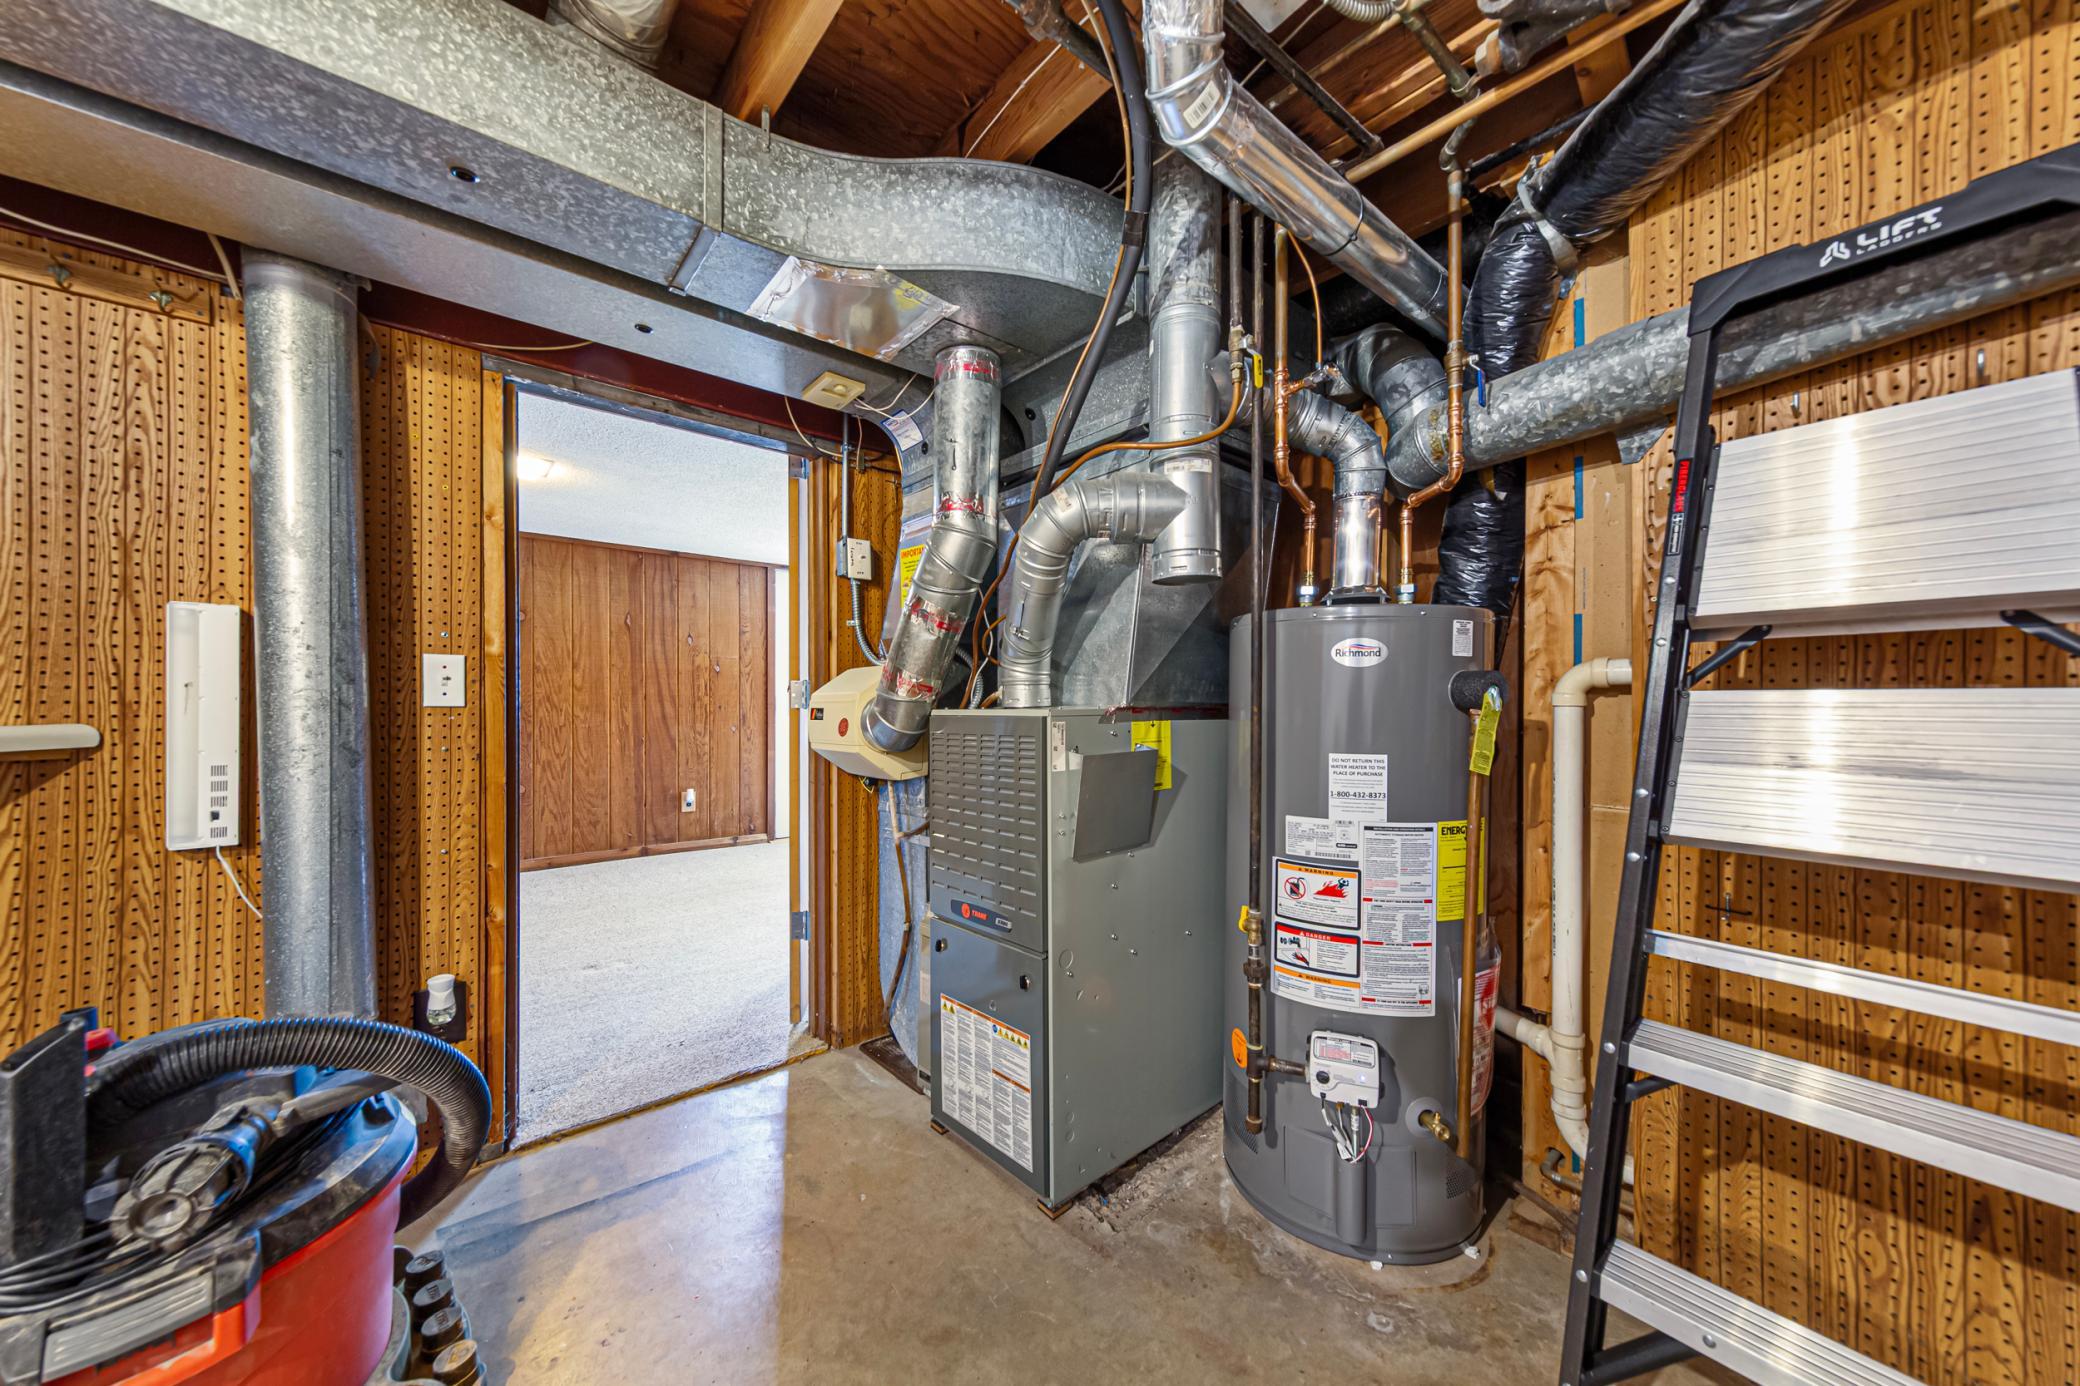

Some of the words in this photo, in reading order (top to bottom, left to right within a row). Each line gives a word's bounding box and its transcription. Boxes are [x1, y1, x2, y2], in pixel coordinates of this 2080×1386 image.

[1856, 206, 1943, 247] LIFT
[1335, 647, 1381, 657] Richmond
[1330, 790, 1386, 799] 1-800-432-8373
[1305, 931, 1331, 941] DANGER
